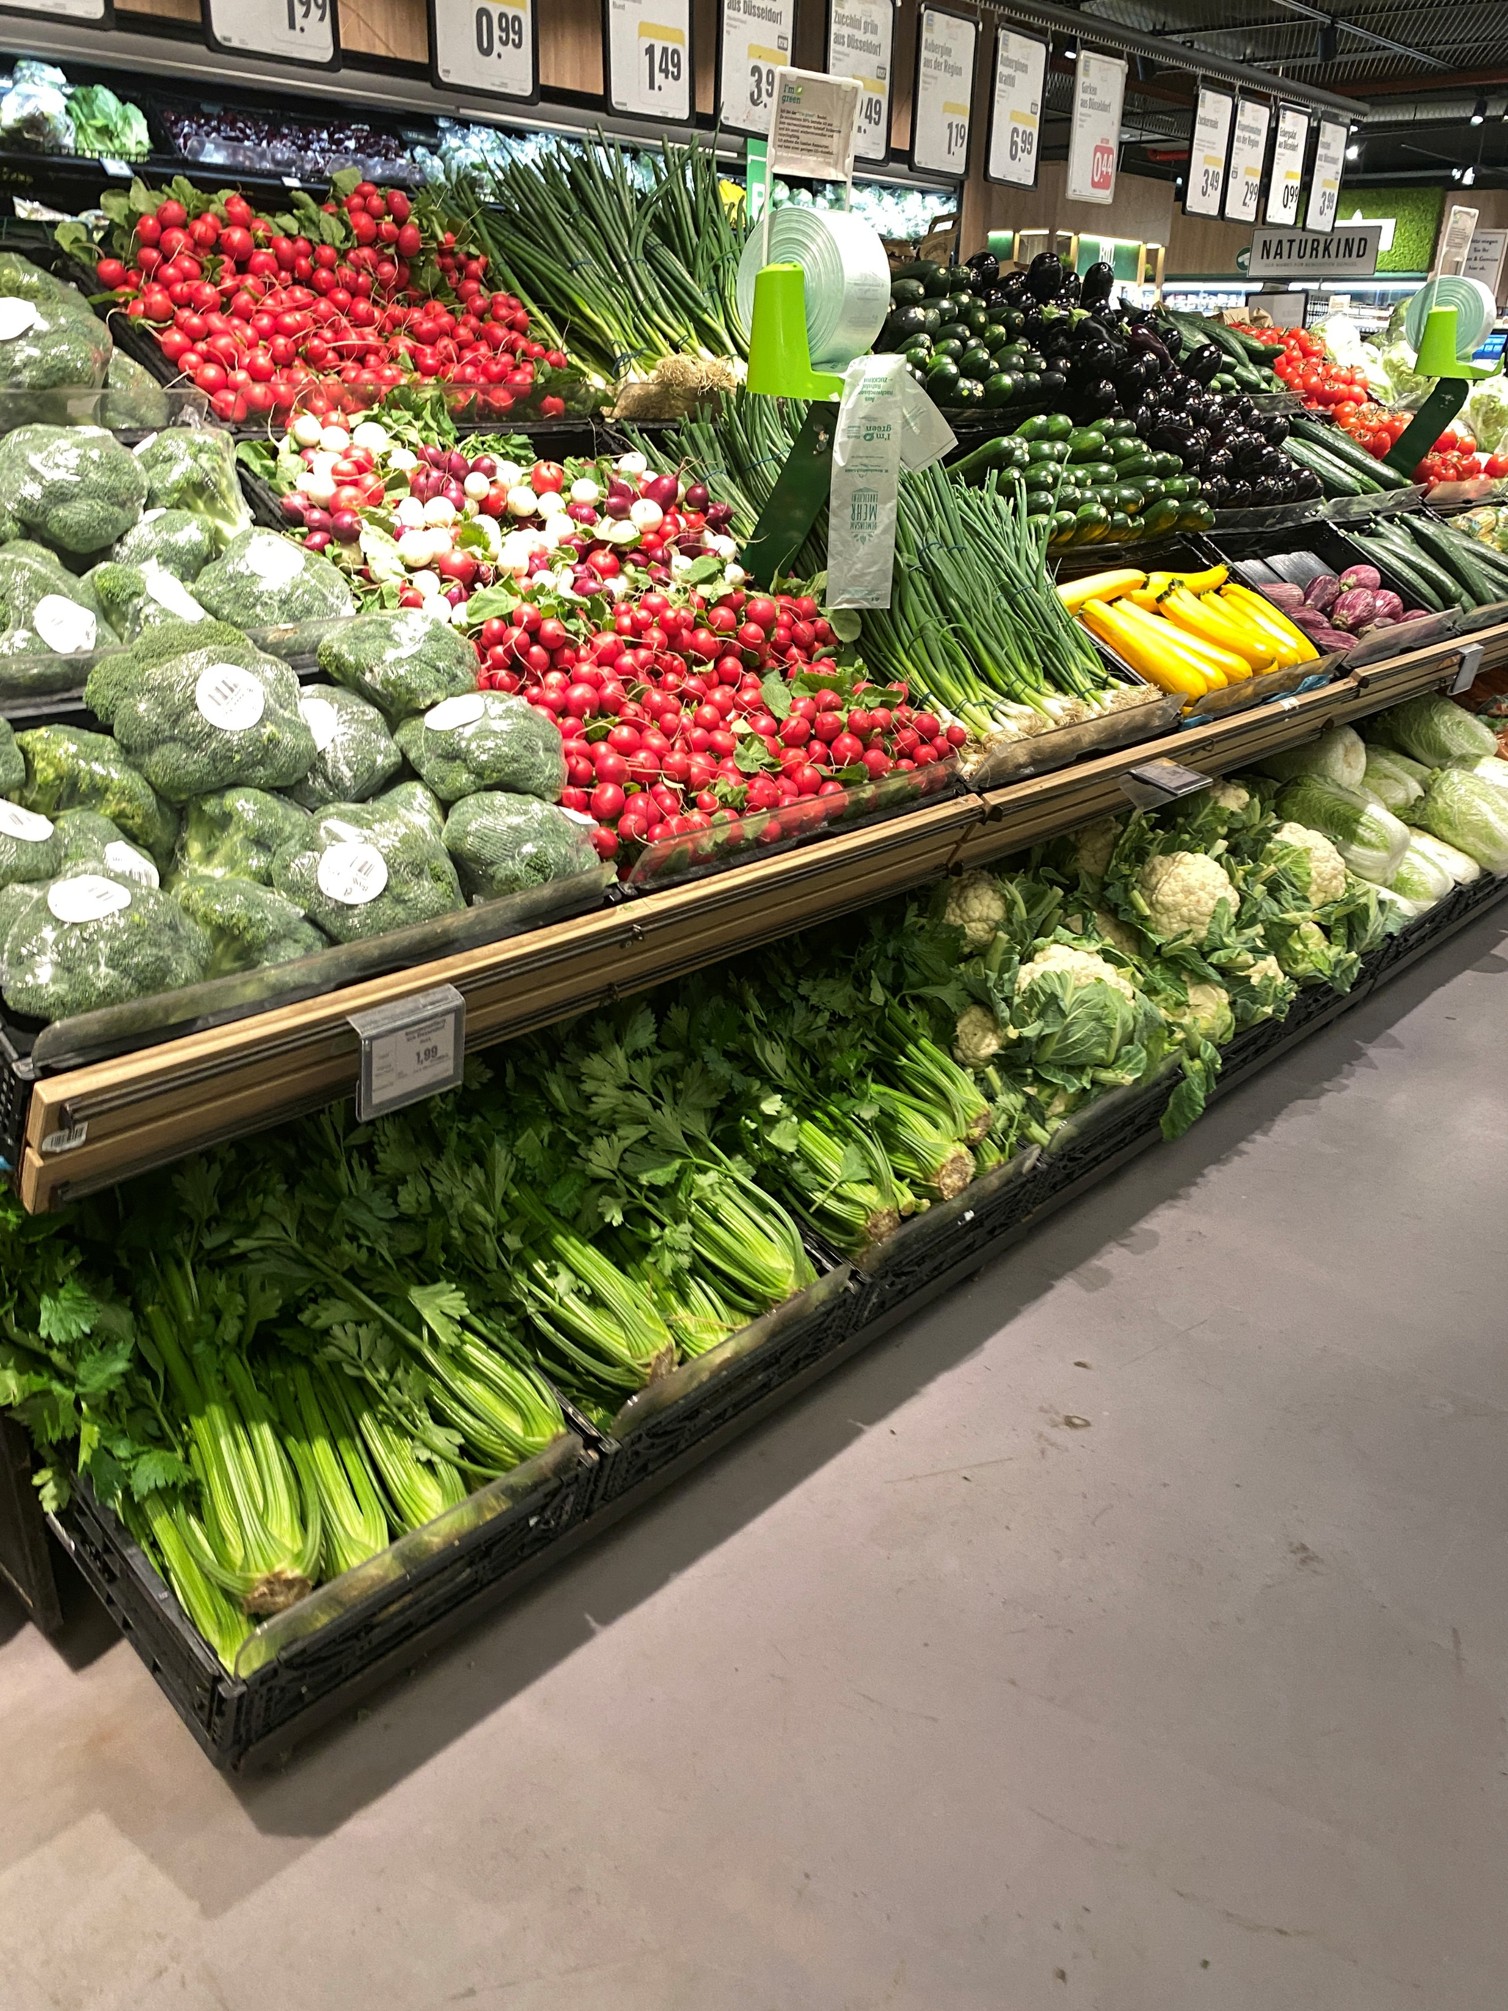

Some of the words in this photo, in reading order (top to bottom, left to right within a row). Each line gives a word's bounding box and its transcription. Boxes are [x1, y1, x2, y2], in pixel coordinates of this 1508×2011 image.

[475, 7, 524, 59] 0.99
[834, 9, 862, 31] Zucchini
[863, 19, 879, 35] grün
[834, 32, 846, 46] aus
[847, 34, 882, 56] Düsseldorf
[644, 43, 682, 91] 1.49
[923, 57, 933, 69] aus
[934, 57, 943, 71] der
[944, 59, 963, 77] Region
[750, 64, 775, 109] 3.9
[783, 83, 795, 94] I'm
[781, 94, 801, 105] green
[947, 121, 966, 157] 1.19
[1009, 127, 1034, 163] 6.99
[1093, 151, 1113, 183] 0.44
[1201, 168, 1220, 198] 3.49
[1242, 181, 1259, 208] 2.99
[1319, 191, 1335, 216] 3.99
[1261, 237, 1368, 260] NATURKIND
[866, 424, 892, 432] green
[876, 432, 890, 441] I'm
[851, 503, 878, 521] MEHR
